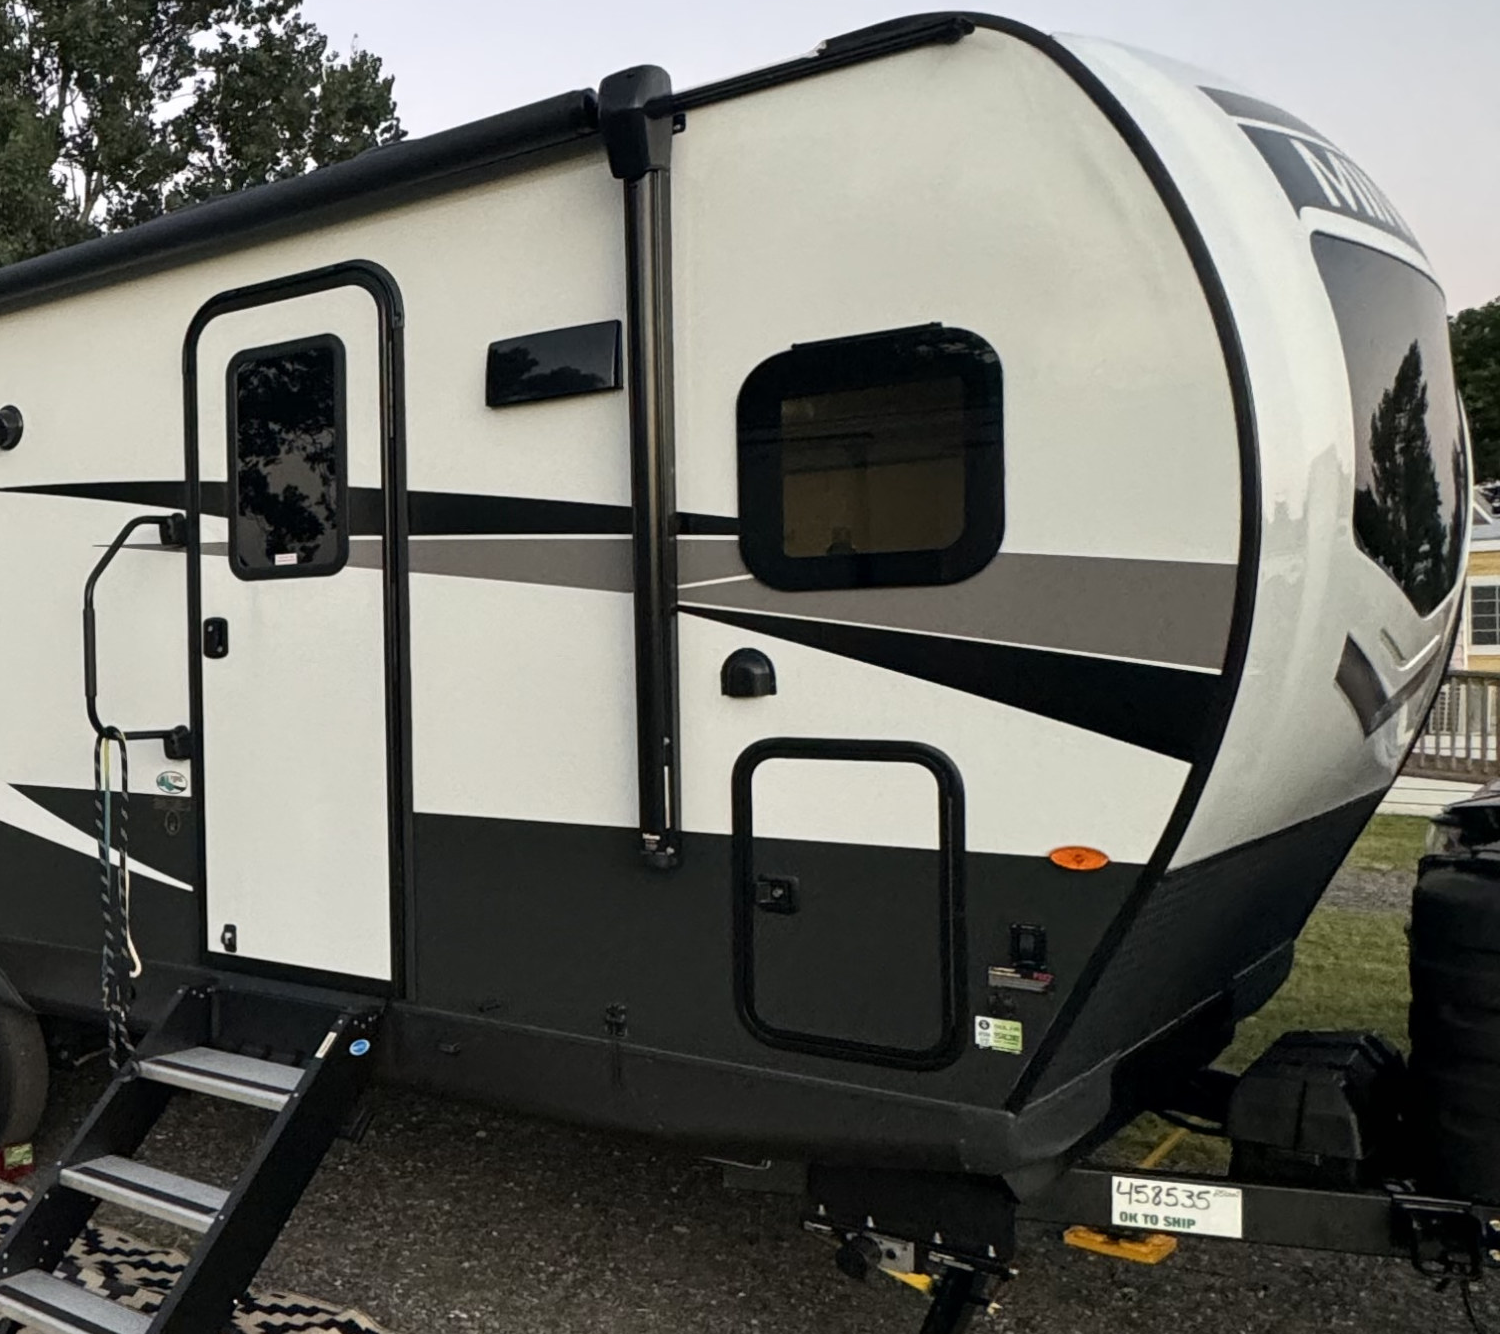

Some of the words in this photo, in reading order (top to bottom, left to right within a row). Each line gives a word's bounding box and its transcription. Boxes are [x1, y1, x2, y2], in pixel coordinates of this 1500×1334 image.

[1115, 1180, 1211, 1211] 458535
[1119, 1211, 1139, 1224] OK
[1141, 1213, 1159, 1226] TO
[1163, 1215, 1196, 1229] SHIP
